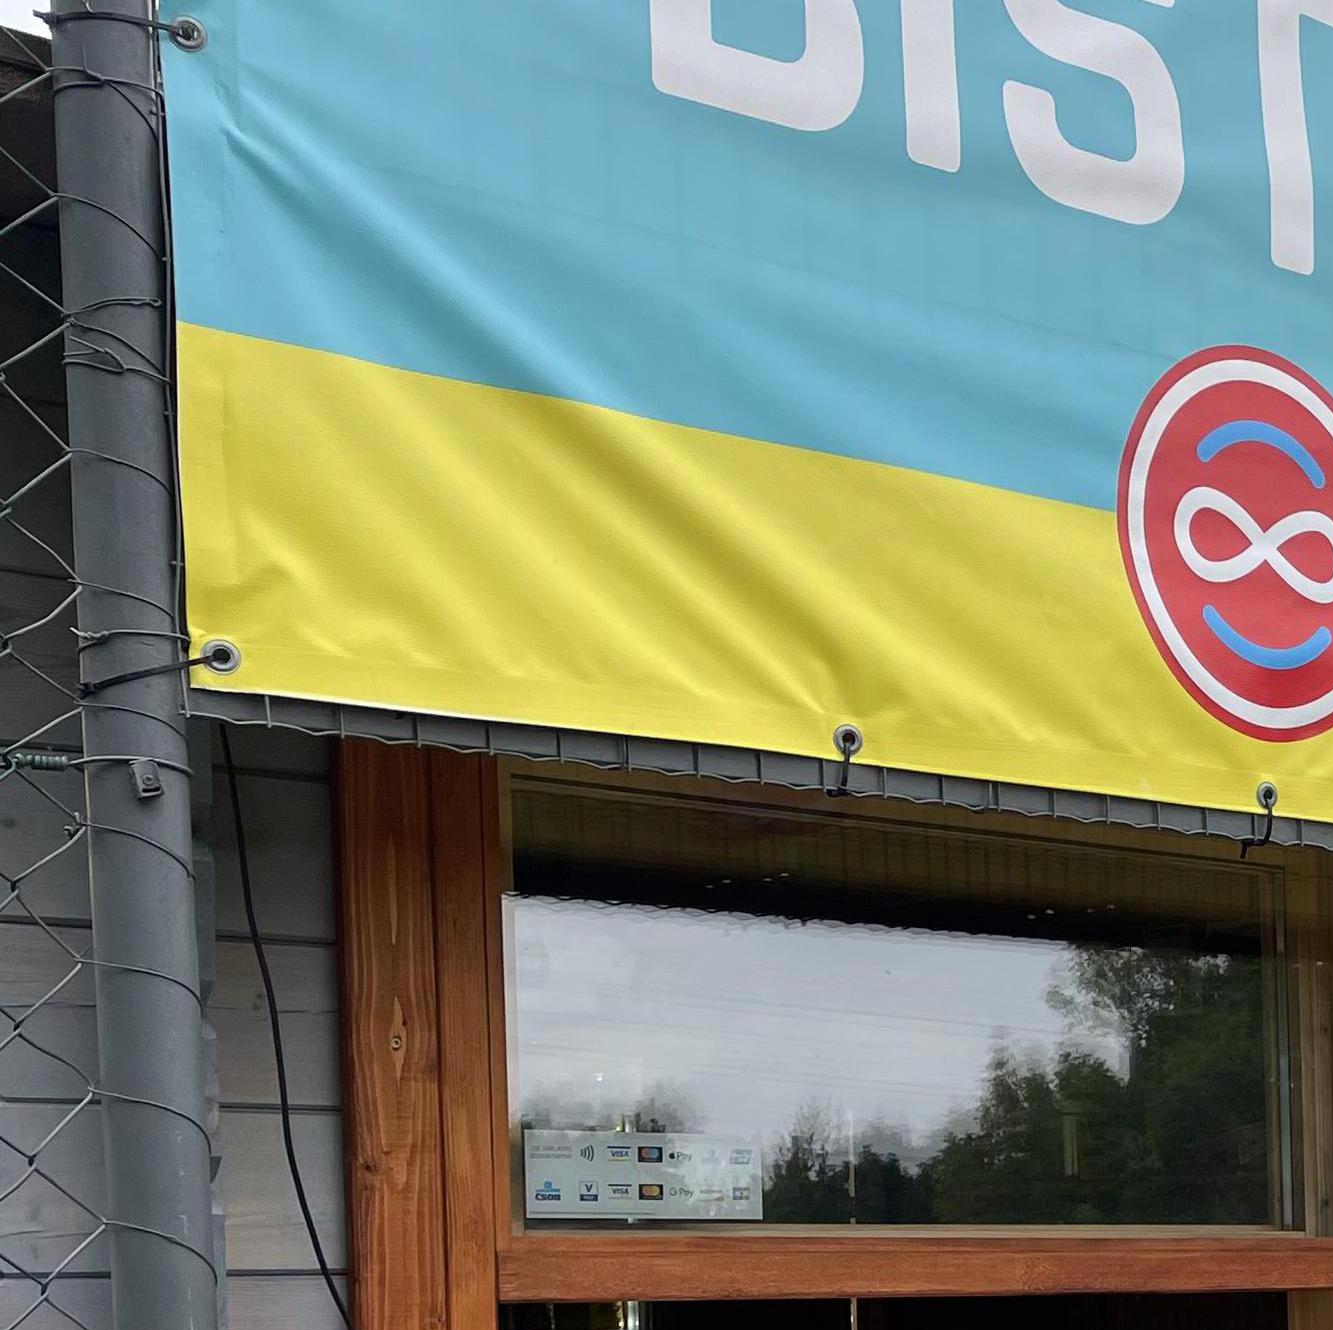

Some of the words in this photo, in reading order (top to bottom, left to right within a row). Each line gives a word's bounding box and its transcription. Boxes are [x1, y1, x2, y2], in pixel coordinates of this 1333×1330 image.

[611, 1150, 630, 1158] VISA
[676, 1151, 693, 1162] Pay
[611, 1187, 630, 1195] VISA
